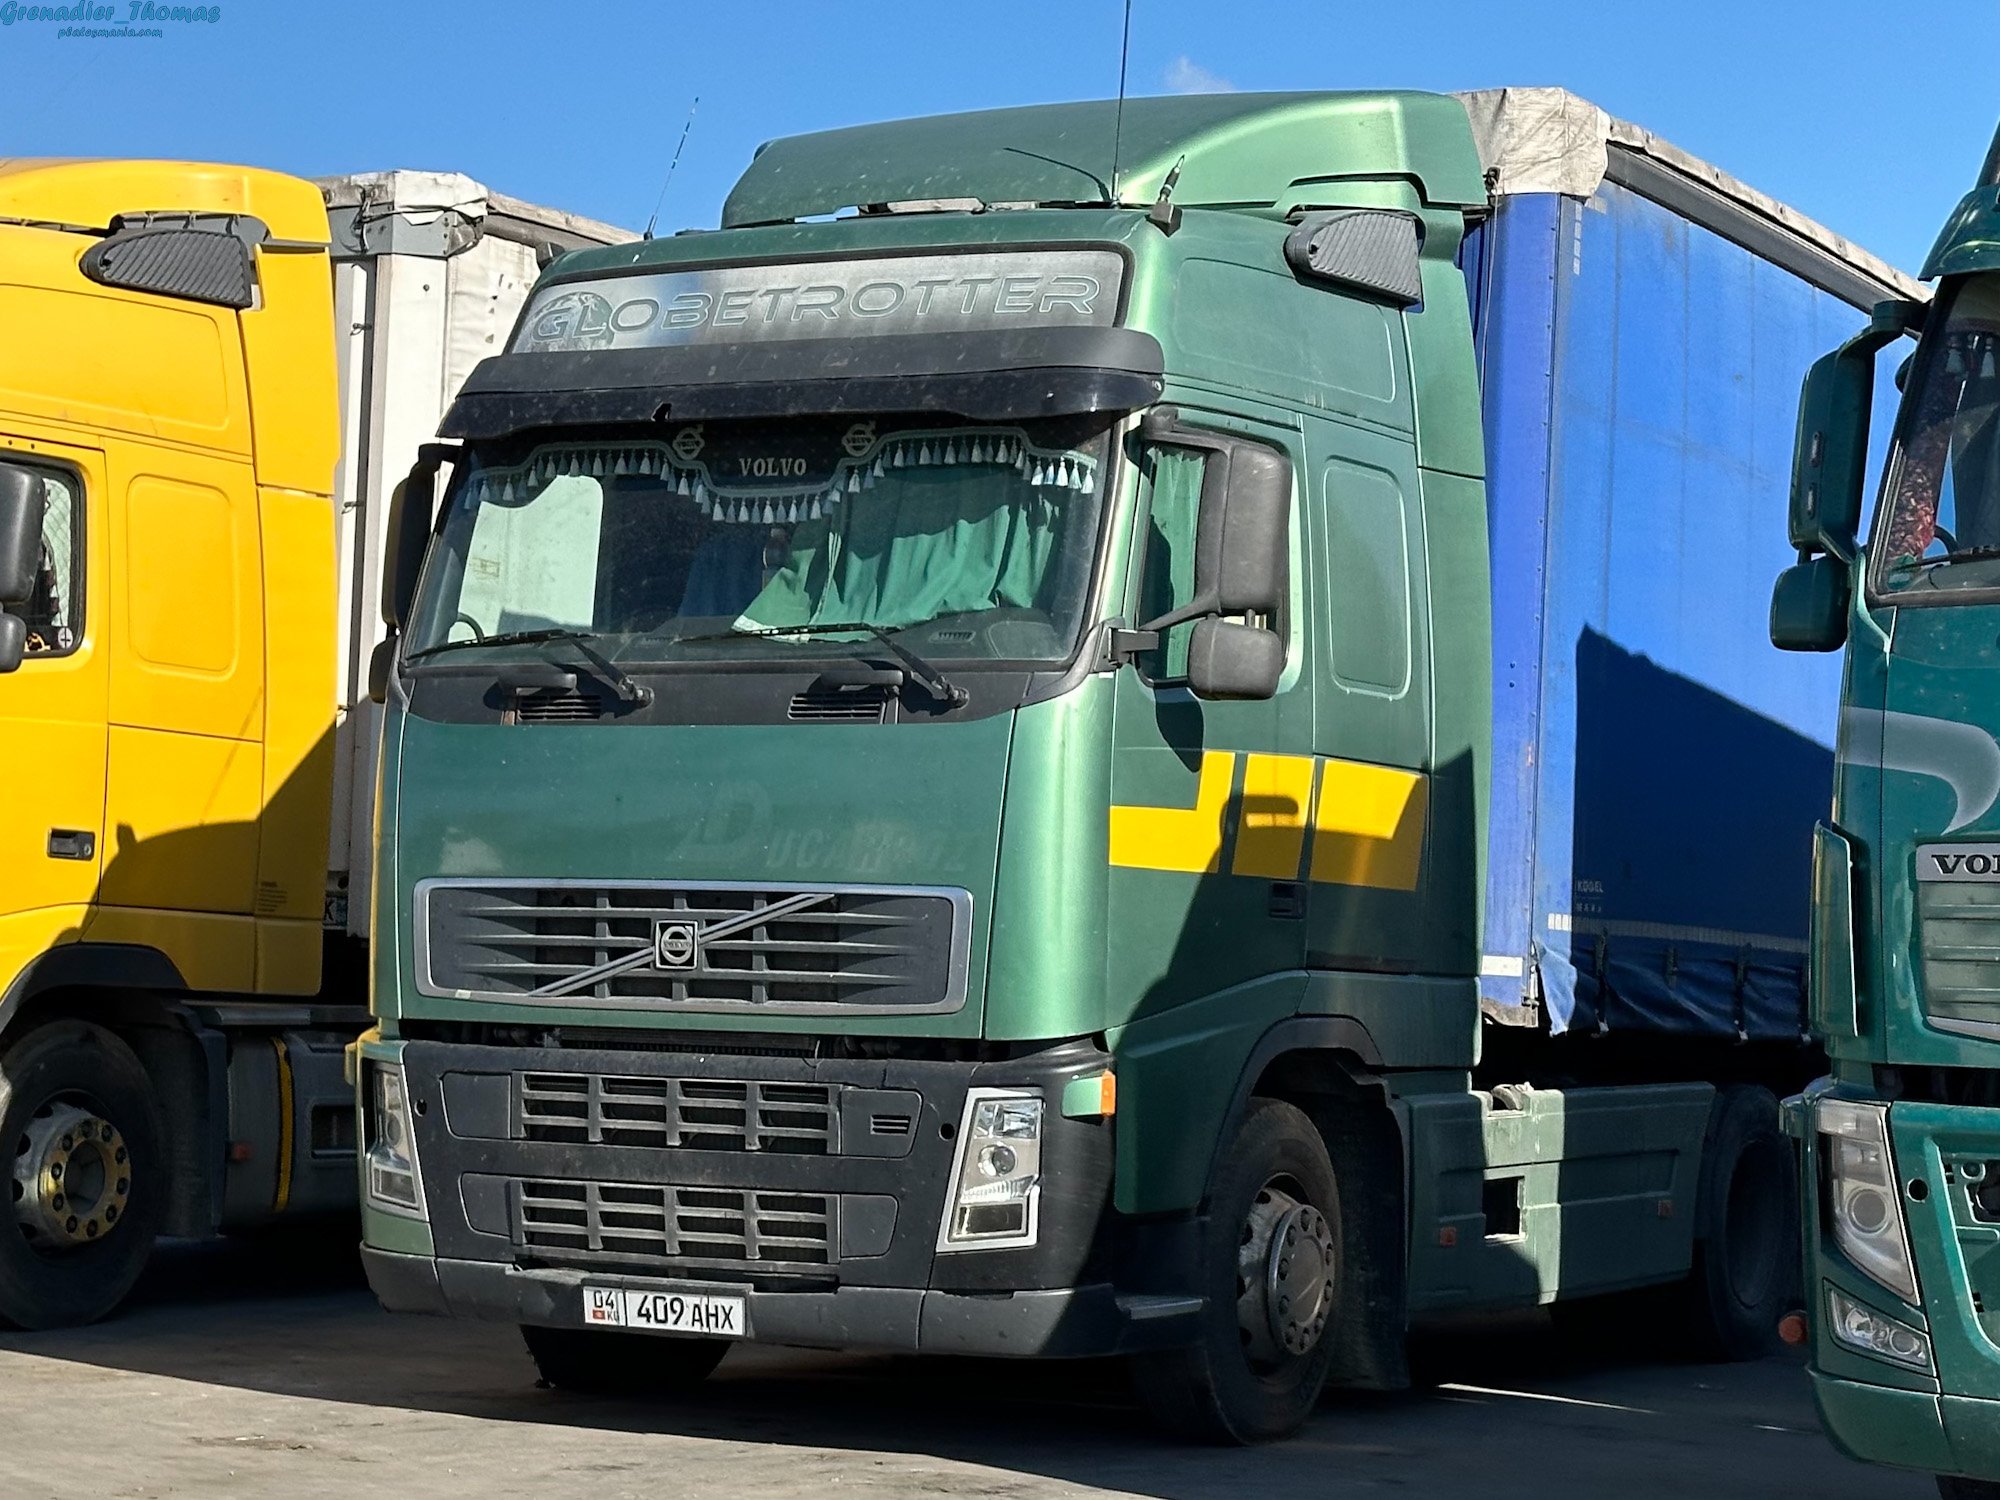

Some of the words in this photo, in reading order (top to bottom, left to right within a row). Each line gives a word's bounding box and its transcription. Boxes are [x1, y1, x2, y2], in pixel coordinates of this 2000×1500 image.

[533, 273, 1100, 342] GLOBETROTTER
[738, 457, 807, 477] VOLVO
[593, 1290, 614, 1309] 04
[637, 1294, 685, 1326] 409
[691, 1303, 734, 1330] AHX
